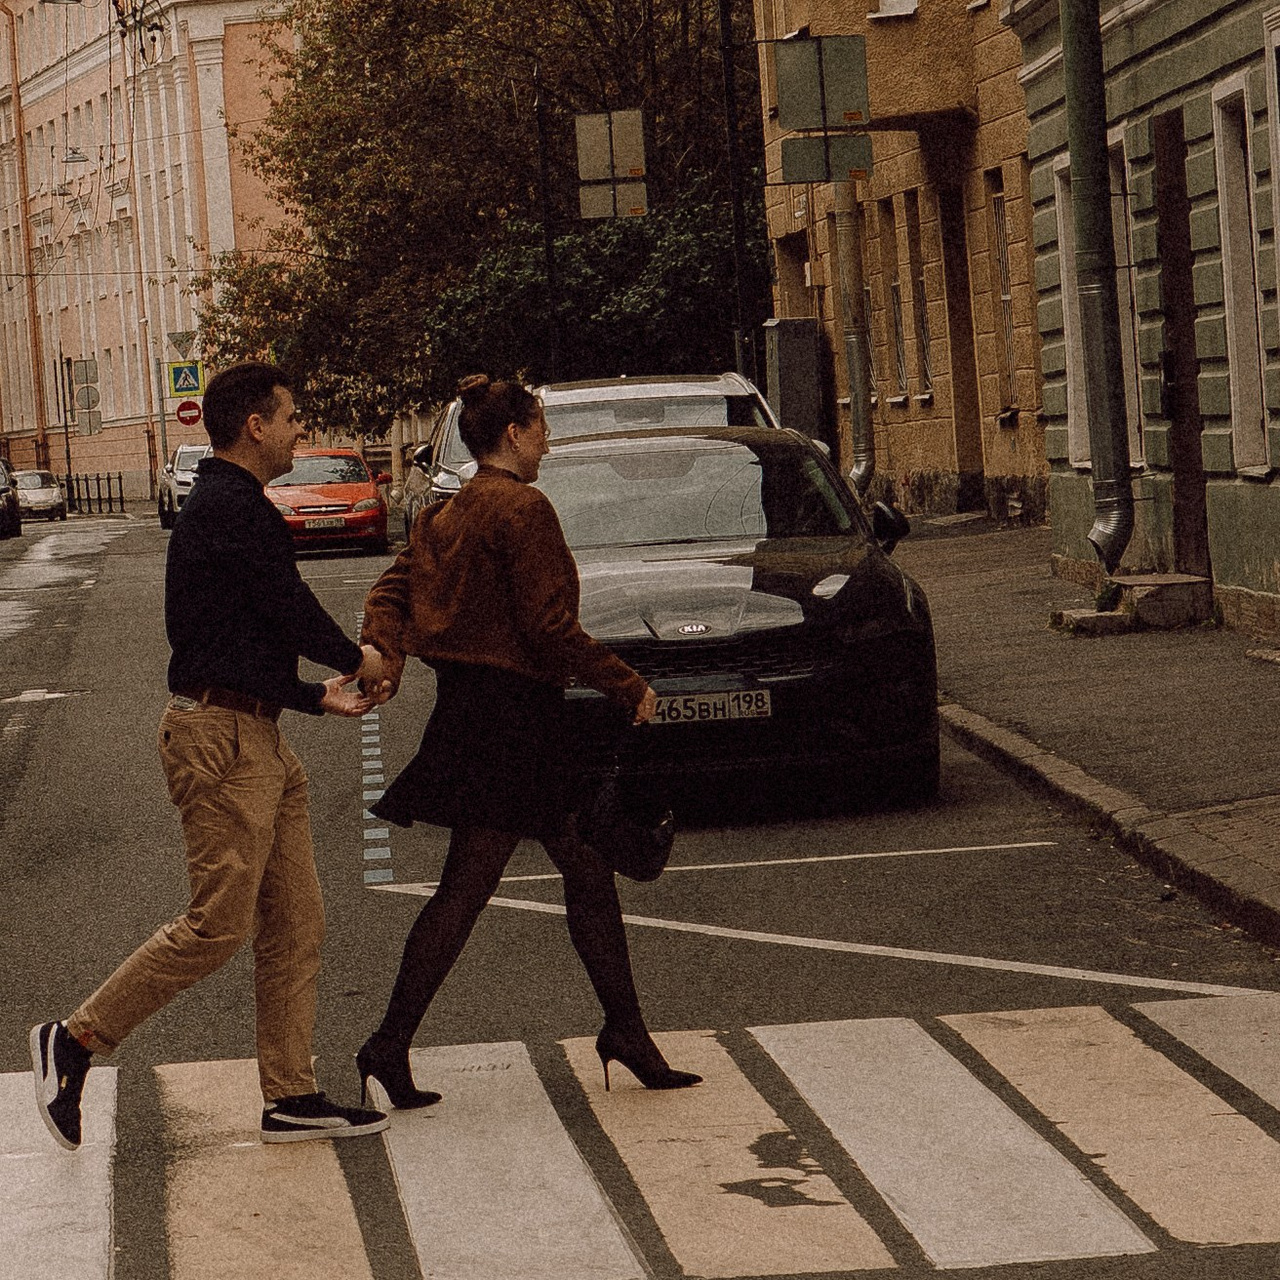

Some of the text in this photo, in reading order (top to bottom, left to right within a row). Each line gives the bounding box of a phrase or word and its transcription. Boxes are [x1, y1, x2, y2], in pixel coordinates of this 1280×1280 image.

[684, 624, 706, 632] KIA
[655, 692, 767, 722] 465ВН 198
